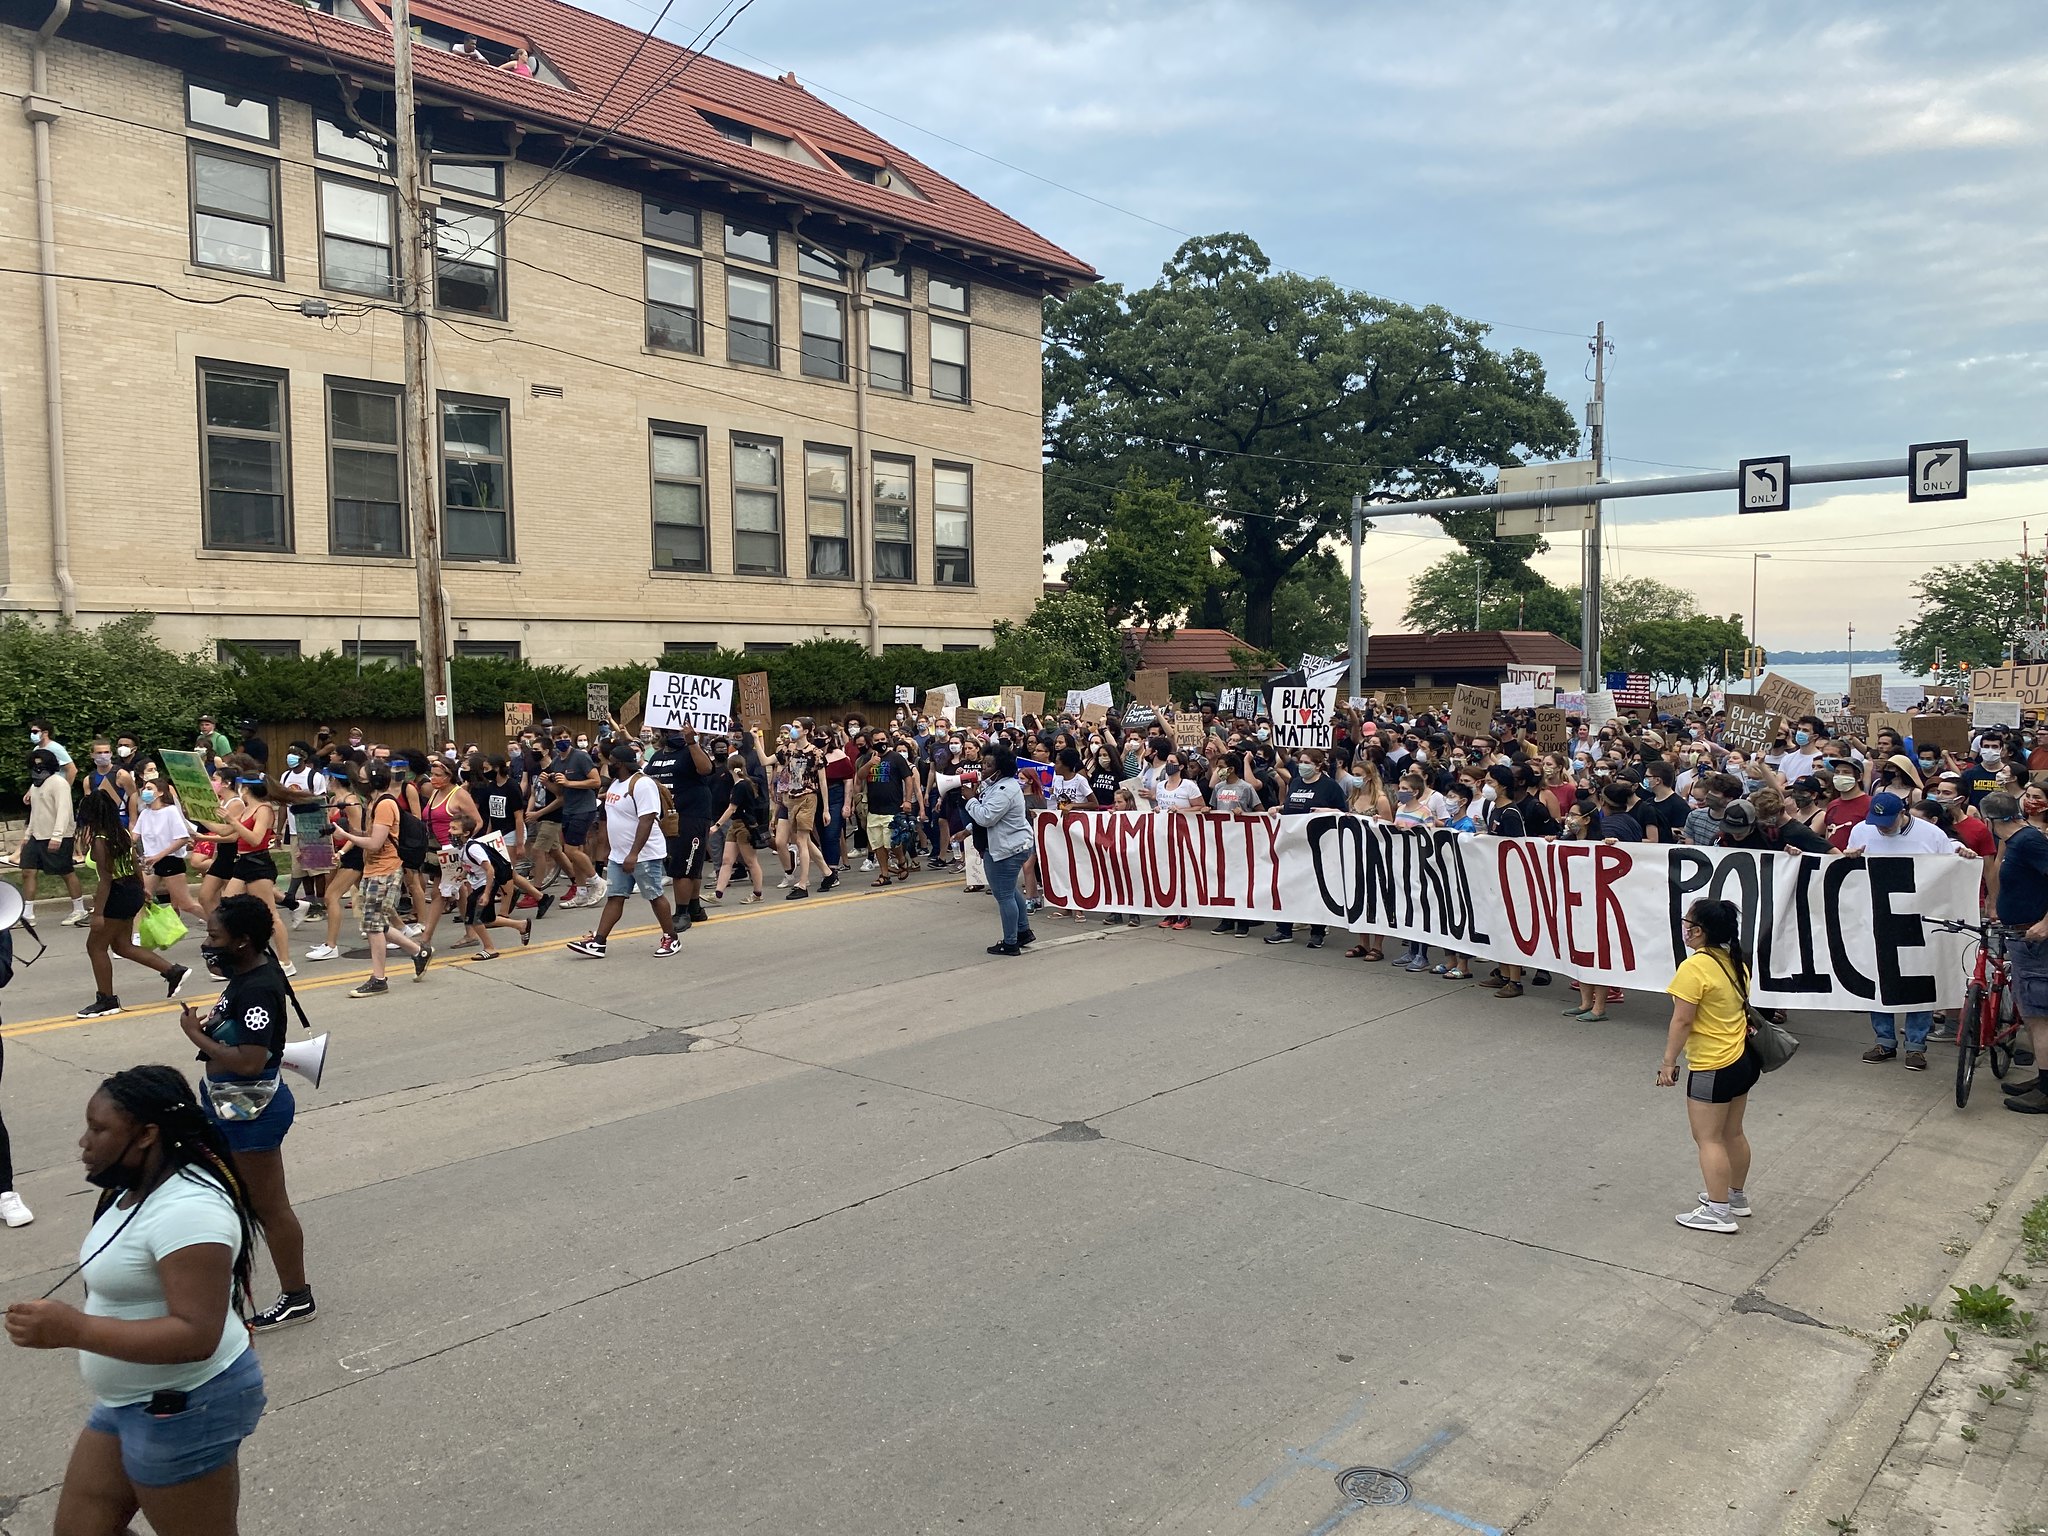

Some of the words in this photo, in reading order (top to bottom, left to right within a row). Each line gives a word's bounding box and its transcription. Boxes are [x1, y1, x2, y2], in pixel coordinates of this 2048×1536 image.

[1923, 480, 1953, 492] ONLY
[1751, 493, 1777, 504] ONLY
[746, 675, 761, 687] END
[1507, 669, 1555, 690] JUSTICE
[1855, 675, 1881, 687] BLACK
[668, 675, 723, 700] BLACK
[1222, 688, 1244, 699] BLACK
[1769, 679, 1812, 706] SILENCE
[744, 687, 766, 701] CASH
[1237, 693, 1255, 703] BLACK
[1282, 688, 1326, 709] BLACK
[1457, 688, 1491, 709] Defund
[1557, 695, 1585, 704] BLACK
[506, 704, 518, 712] We
[652, 694, 698, 711] LIVES
[1236, 701, 1254, 711] LIVES
[1815, 698, 1840, 706] DEFUND
[589, 704, 608, 713] BLACK
[745, 703, 767, 717] BAIL
[1462, 706, 1477, 716] the
[1817, 706, 1839, 714] POLICE
[590, 712, 607, 720] LIVES
[666, 709, 728, 733] MATTER
[1175, 713, 1203, 722] BLACK
[1538, 712, 1561, 722] COPS
[1731, 705, 1773, 730] BLACK
[1835, 716, 1865, 725] DEFUND
[1176, 724, 1201, 732] LIVES
[1455, 715, 1482, 731] Police
[1540, 723, 1560, 732] OUT
[1730, 720, 1767, 740] LIVES
[1837, 724, 1867, 735] POLICE
[1274, 725, 1331, 748] MATTER
[1543, 733, 1556, 741] OF
[1721, 730, 1773, 755] MATTER
[1538, 741, 1567, 753] SCHOOLS
[1037, 811, 1281, 910] COMMUNITY
[1307, 814, 1491, 945] CONTROL
[1498, 839, 1636, 972] OVER
[1668, 847, 1937, 1006] POLICE
